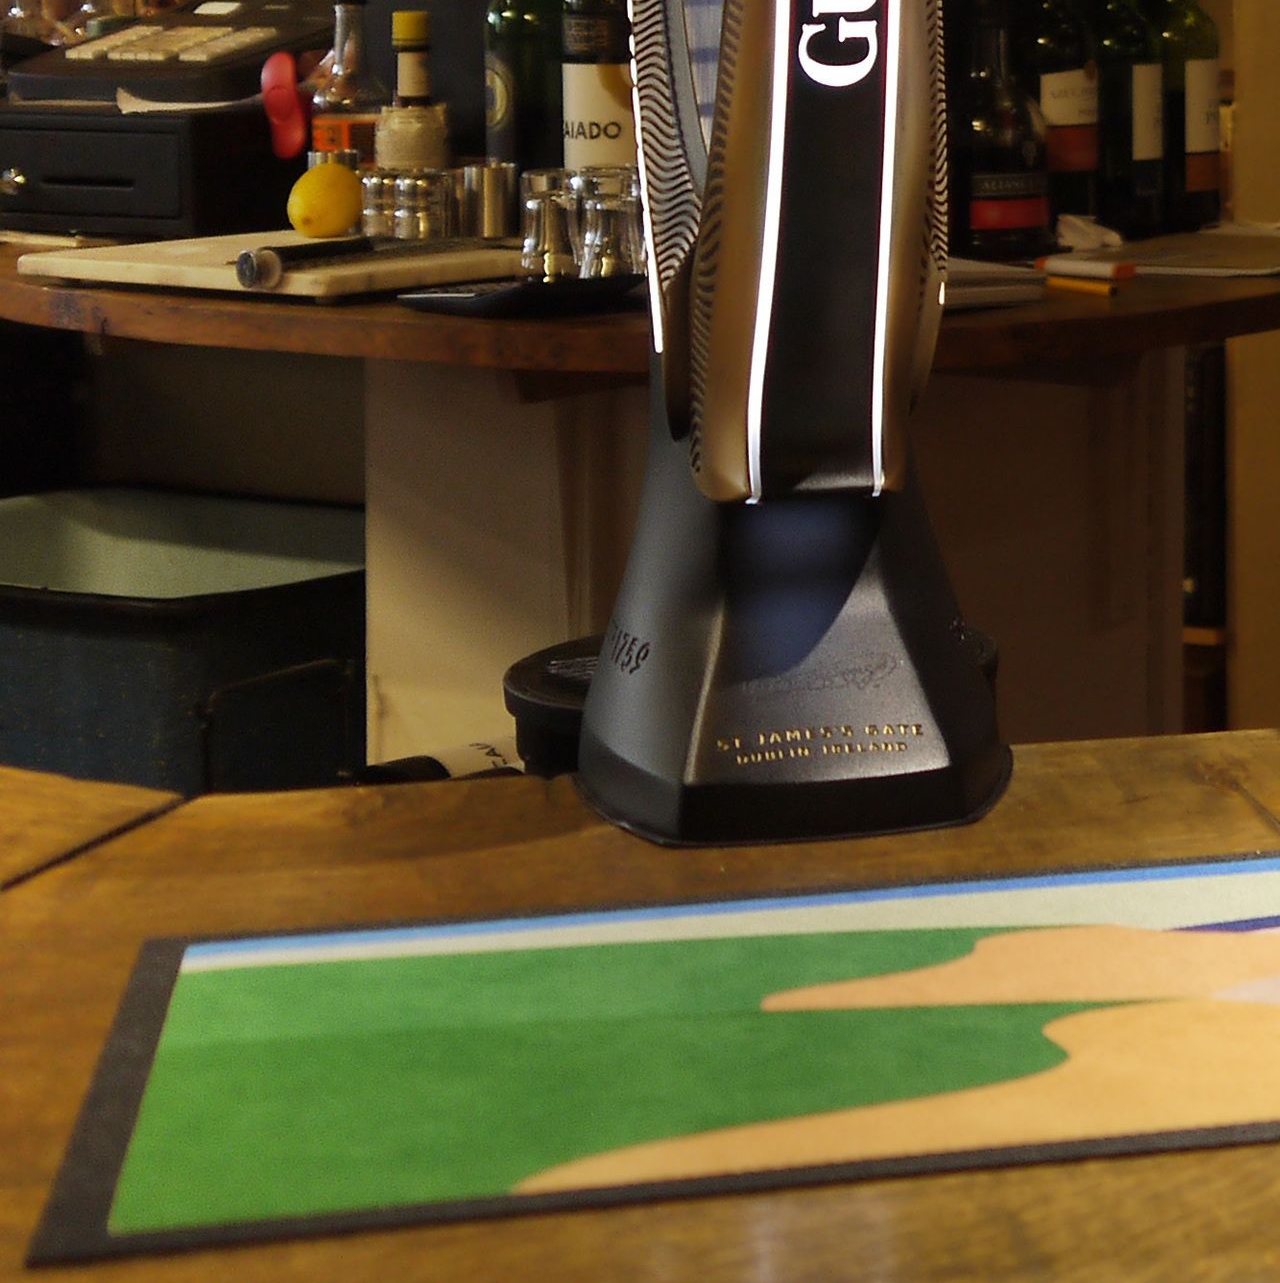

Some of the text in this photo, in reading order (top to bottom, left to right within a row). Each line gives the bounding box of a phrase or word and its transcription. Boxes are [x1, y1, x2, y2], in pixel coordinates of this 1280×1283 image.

[864, 722, 924, 738] GATE
[735, 741, 909, 767] DUBLIN IRELAND
